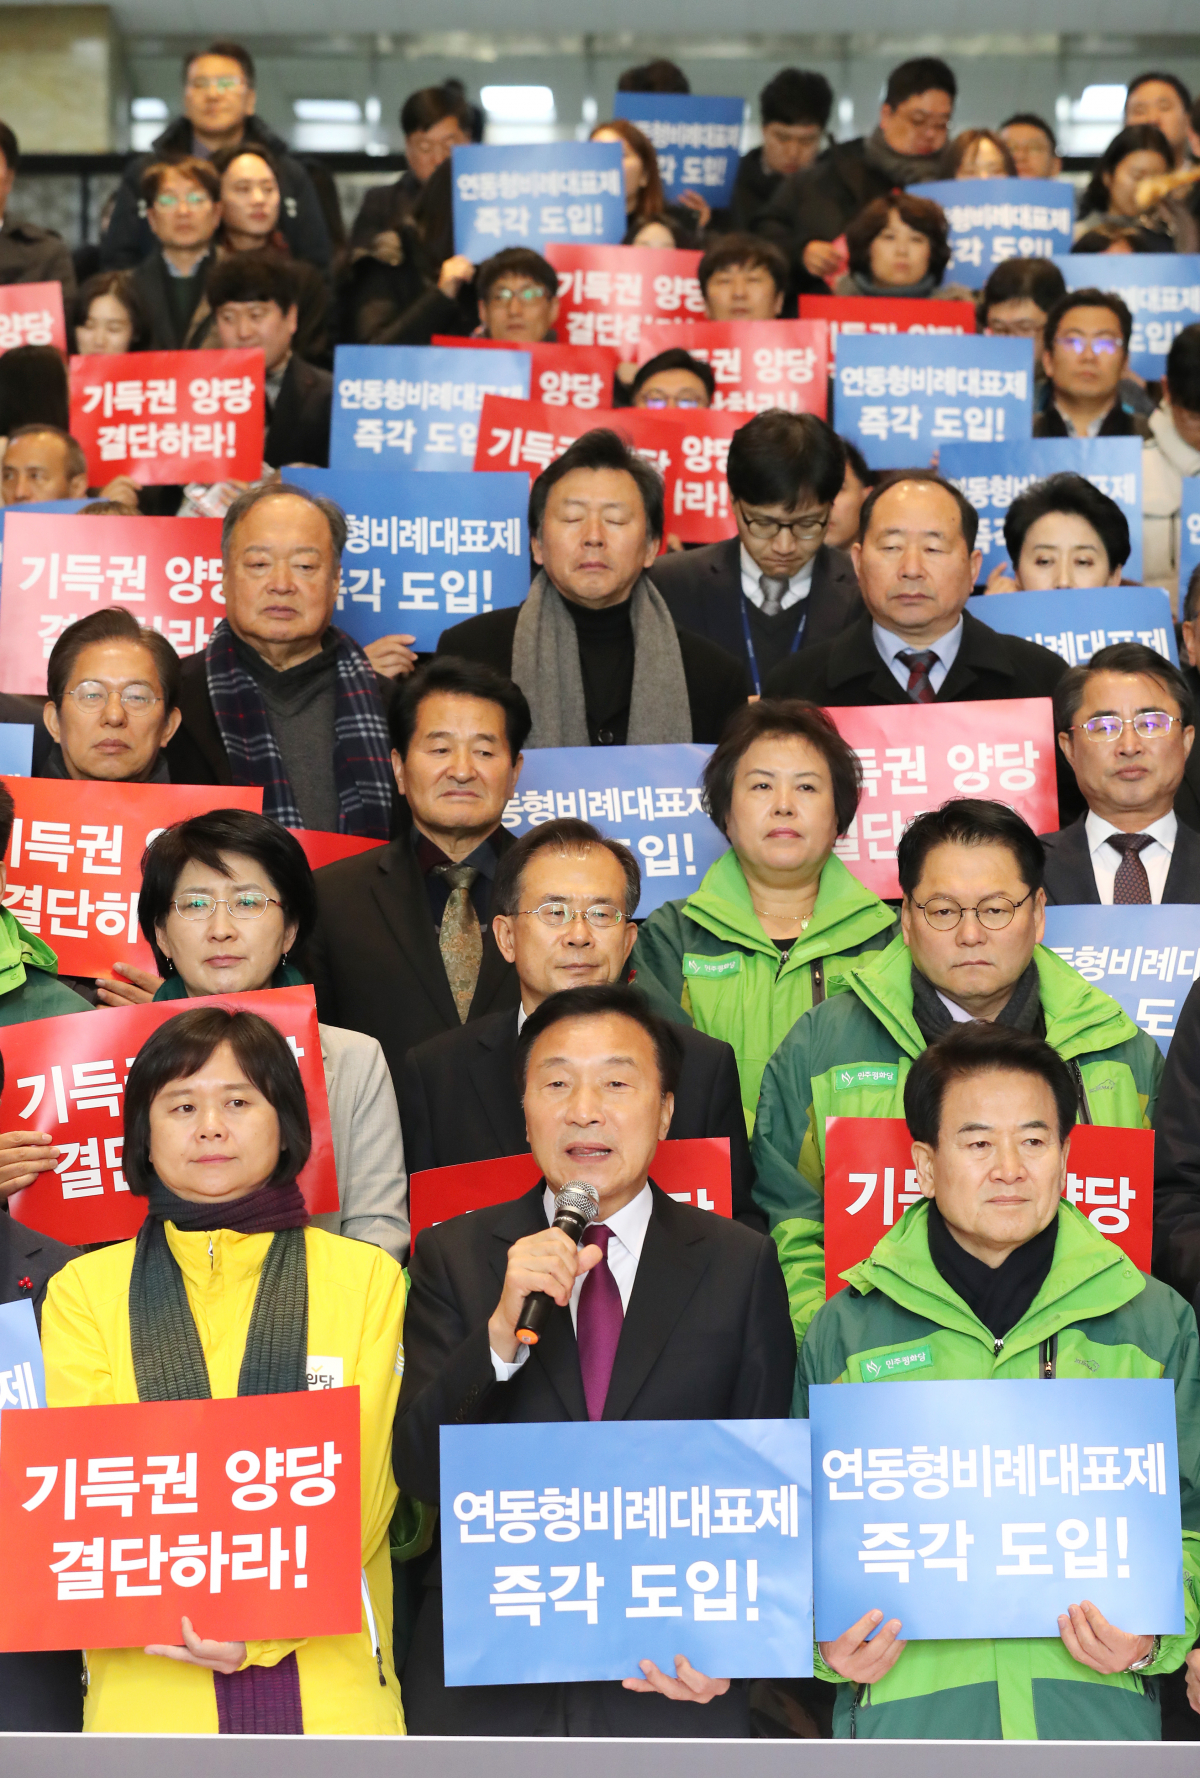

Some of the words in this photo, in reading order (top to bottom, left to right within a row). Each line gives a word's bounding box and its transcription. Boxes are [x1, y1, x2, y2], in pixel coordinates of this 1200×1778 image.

[473, 204, 531, 238] 즉각
[539, 203, 604, 236] 도입!
[946, 203, 1071, 235] 형비례대표제
[753, 347, 817, 384] 양당
[840, 365, 1028, 402] 연동형비례대표제
[82, 377, 177, 418] 기득권
[188, 376, 255, 415] 양당
[538, 371, 604, 409] 양당
[97, 421, 237, 461] 결단하라!
[353, 418, 417, 454] 즉각
[858, 405, 922, 441] 즉각
[931, 405, 1005, 442] 도입!
[487, 426, 575, 470] 기득
[19, 552, 146, 601] 기득권
[398, 569, 493, 614] 도입!
[946, 740, 1040, 794] 양당
[16, 1056, 135, 1124] 기득
[857, 1071, 894, 1081] 민주평화당
[885, 1352, 926, 1369] 민주평화당
[21, 1452, 199, 1520] 기득권
[224, 1440, 342, 1511] 양당
[822, 1442, 1167, 1501] 연동형비례대표제
[453, 1484, 799, 1544] 연동형비례대표제
[48, 1525, 308, 1601] 결단하라!
[858, 1519, 975, 1583] 즉각
[996, 1516, 1131, 1579] 도입!
[489, 1562, 605, 1627] 즉각
[625, 1559, 760, 1622] 도입!
